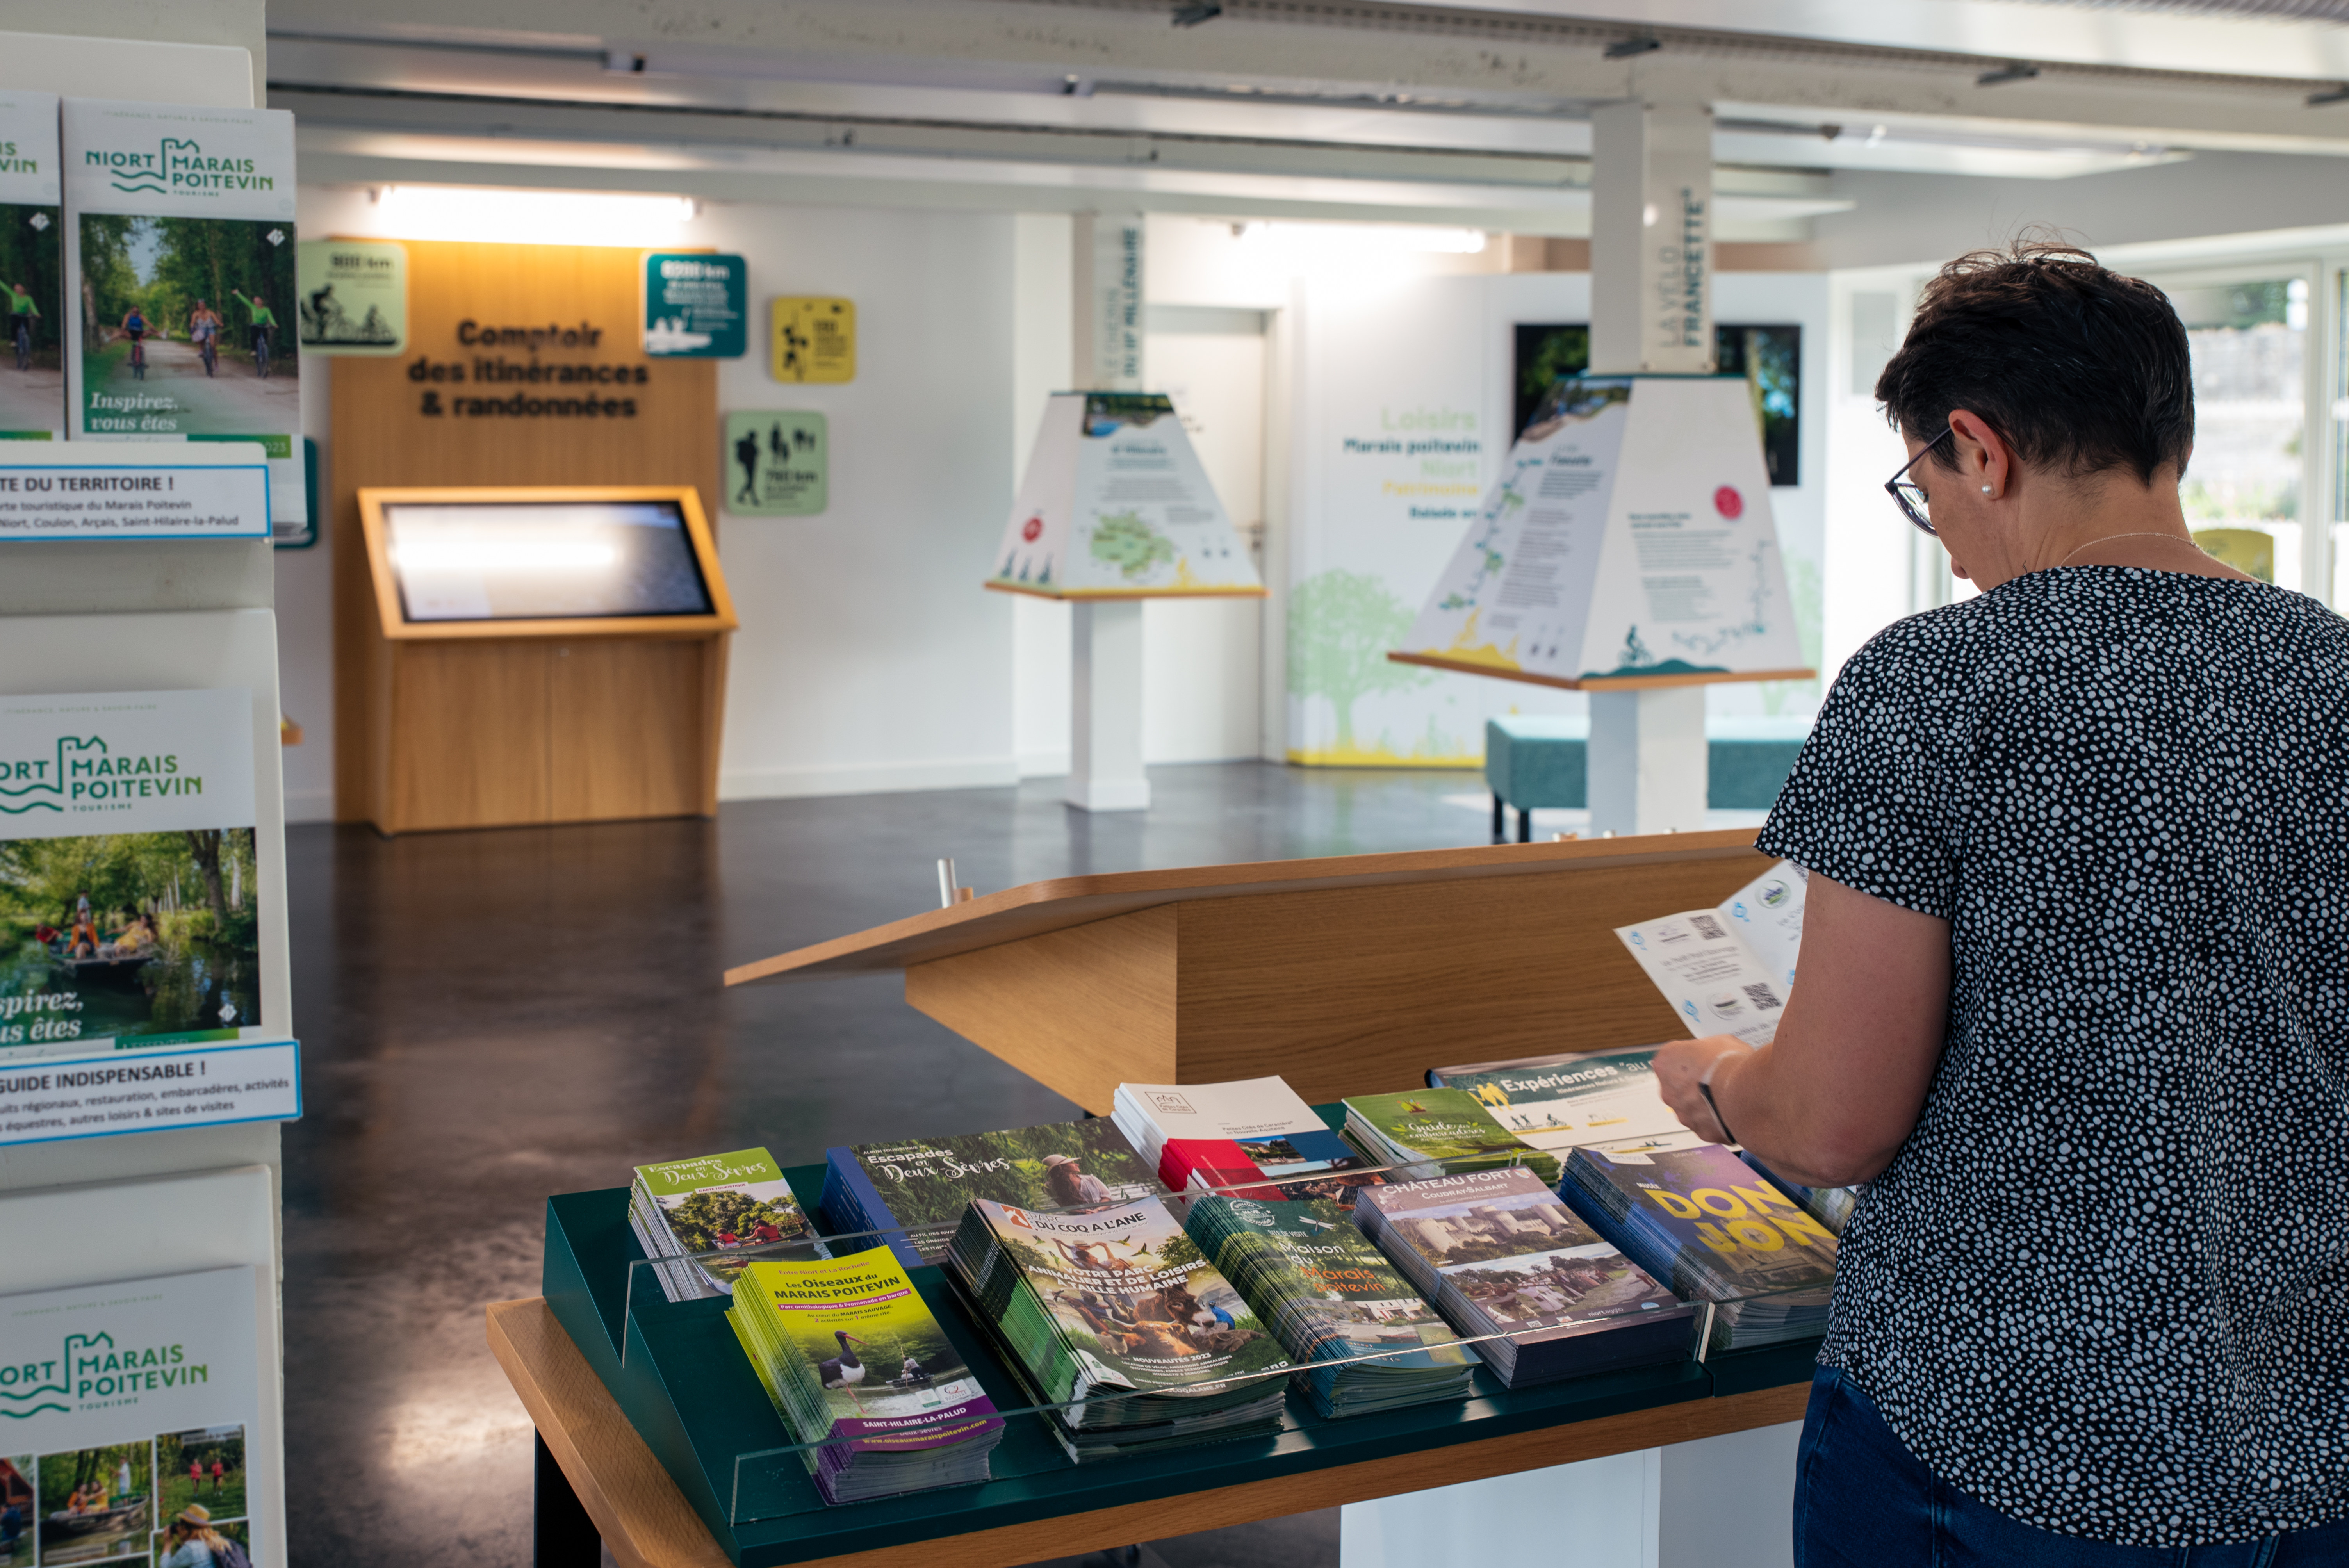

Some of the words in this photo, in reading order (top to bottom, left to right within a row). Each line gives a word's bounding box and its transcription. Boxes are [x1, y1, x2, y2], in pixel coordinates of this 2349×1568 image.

[86, 151, 155, 167] NIORT
[172, 155, 254, 173] MARAIS
[173, 172, 273, 191] POITEVIN
[457, 318, 602, 352] Comptoir
[407, 356, 465, 383] des
[473, 355, 649, 383] itinérances
[89, 392, 178, 412] Inspirez,
[420, 390, 443, 416] &
[454, 391, 638, 417] randonnées
[91, 417, 136, 430] vous
[141, 413, 177, 430] êtes
[1381, 406, 1478, 430] Loisirs
[1343, 437, 1403, 453] Marais
[1407, 438, 1481, 456] poitevin
[25, 478, 52, 491] DU
[58, 477, 162, 490] TERRITOIRE
[169, 476, 173, 490] !
[21, 501, 83, 511] touristique
[87, 501, 102, 510] du
[105, 501, 143, 510] Marais
[146, 500, 192, 510] Poitevin
[34, 517, 77, 529] Coulon,
[81, 517, 118, 528] Arçais,
[122, 516, 239, 527] Saint-Hilaire-la-Palud
[71, 755, 178, 777] MARAIS
[71, 776, 202, 800] POITEVIN
[73, 803, 132, 812] TOURISME
[29, 1017, 82, 1041] êtes
[56, 1062, 194, 1088] INDISPENSABLE
[201, 1060, 205, 1076] !
[1499, 1066, 1619, 1092] Expériences
[22, 1099, 82, 1113] régionaux,
[86, 1092, 157, 1105] restauration,
[161, 1083, 242, 1099] embarcadères,
[245, 1076, 289, 1091] activités
[6, 1118, 67, 1131] équestres,
[70, 1114, 105, 1125] autres
[108, 1109, 140, 1121] loisirs
[144, 1107, 153, 1117] &
[156, 1106, 181, 1116] sites
[184, 1103, 197, 1113] de
[201, 1101, 235, 1112] visites
[1408, 1121, 1456, 1133] Guide
[648, 1158, 722, 1173] Escapades
[867, 1149, 954, 1164] Escapades
[658, 1162, 768, 1185] Deux-Sèvres
[876, 1157, 1011, 1183] Deux-Sèvres
[1382, 1175, 1465, 1194] CHÂTEAU
[1466, 1169, 1512, 1183] FORT
[1421, 1183, 1509, 1199] COUDRAY-SALBART
[1643, 1180, 1798, 1219] DON
[1028, 1212, 1065, 1224] PARC
[1034, 1220, 1055, 1230] DU
[1058, 1224, 1090, 1233] COQ
[1121, 1221, 1149, 1231] Restauration
[1693, 1211, 1838, 1252] JON
[1278, 1242, 1345, 1254] Maison
[838, 1261, 870, 1271] Rochelle
[1290, 1253, 1314, 1264] du
[1028, 1264, 1103, 1286] ANIMALIER
[1105, 1277, 1124, 1286] ET
[1126, 1274, 1147, 1285] DE
[1150, 1259, 1207, 1281] LOISIRS
[1062, 1265, 1113, 1278] VOTRE
[1114, 1265, 1155, 1277] PARC
[1299, 1265, 1375, 1280] Marais
[774, 1290, 831, 1299] MARAIS
[832, 1276, 900, 1297] POITEVIN
[802, 1275, 863, 1288] Oiseaux
[1057, 1274, 1068, 1287] À
[1069, 1281, 1117, 1294] TAILLE
[1120, 1274, 1189, 1294] HUMAINE
[1314, 1281, 1386, 1293] poitevin
[844, 1298, 878, 1308] Promenade
[887, 1290, 909, 1300] barque
[864, 1304, 893, 1314] SAUVAGE,
[1588, 1307, 1624, 1317] niortagglo
[78, 1344, 184, 1376] MARAIS
[1190, 1352, 1212, 1361] 2023
[1200, 1355, 1232, 1365] ANIMALIÈRES
[1184, 1360, 1229, 1372] SCÉNOGRAPHIQUE
[79, 1364, 208, 1399] POITEVIN
[79, 1397, 139, 1411] TOURISME
[863, 1407, 966, 1428] SAINT-HILAIRE-LA-PALUD
[862, 1419, 987, 1444] www.oiseauxmaraispoitevin.com
